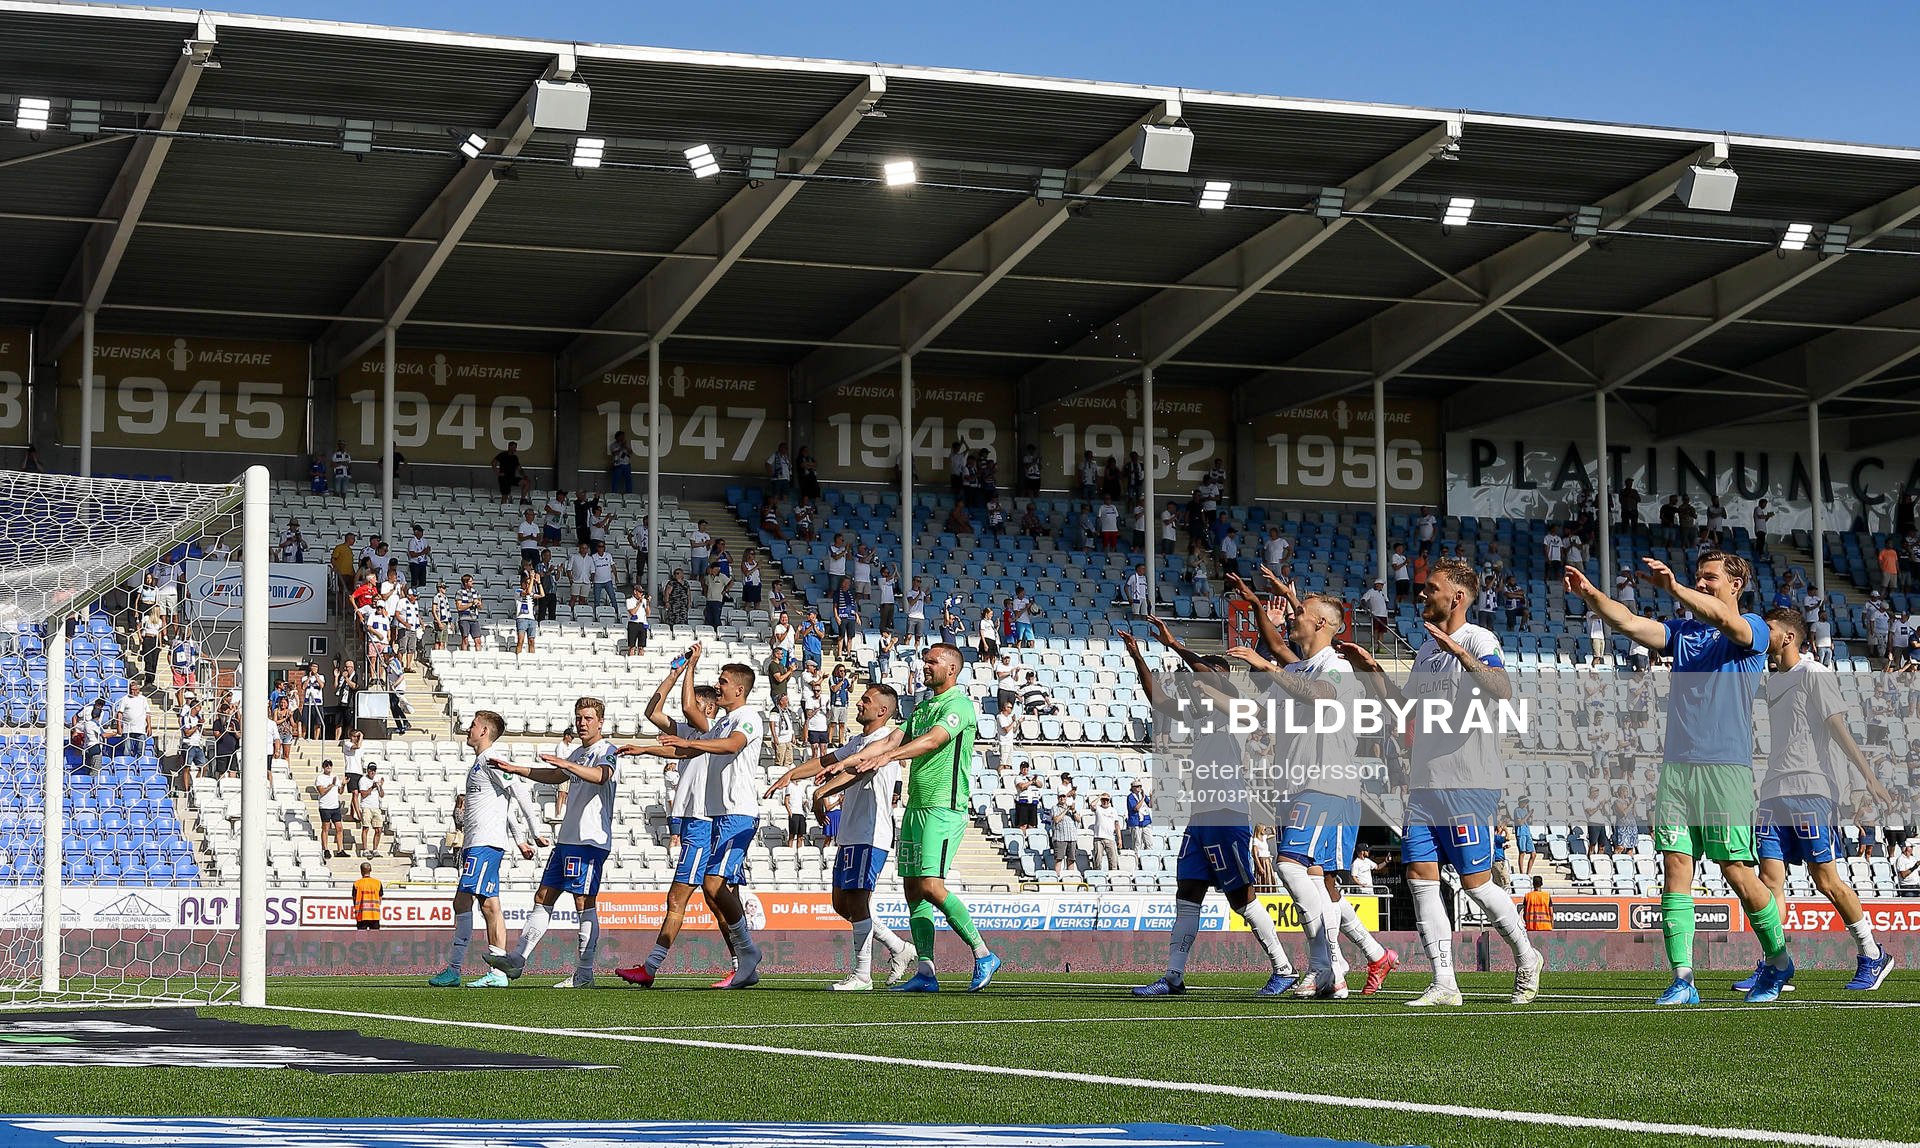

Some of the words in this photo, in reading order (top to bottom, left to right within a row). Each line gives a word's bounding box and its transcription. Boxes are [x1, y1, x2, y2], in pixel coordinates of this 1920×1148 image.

[92, 346, 161, 360] SVENSKA
[199, 350, 272, 365] MÄSTARE
[457, 366, 521, 379] MÄSTARE
[602, 373, 663, 386] SVENSA
[695, 377, 756, 391] MÄSTARE
[837, 386, 895, 398] SVENSKA
[925, 389, 985, 402] MÄSTARE
[78, 375, 285, 440] 1945
[350, 389, 534, 451] 1946
[1356, 410, 1412, 424] MÄTARE
[596, 401, 766, 461] 1947
[828, 412, 997, 470] 1948
[1053, 423, 1215, 482] 1952
[1266, 433, 1424, 490] 1956
[312, 638, 324, 653] L
[1419, 678, 1459, 695] OLMEN
[306, 905, 402, 921] STENGS
[407, 907, 425, 921] EL
[429, 907, 452, 921] AB
[596, 901, 659, 912] Tillsammans
[772, 904, 789, 914] DU
[791, 902, 809, 914] ÄR
[968, 902, 1041, 914] STÅTHÖGA
[1058, 902, 1131, 914] STÅTHÖGA
[973, 918, 1022, 928] ERKSTAD
[1023, 918, 1039, 928] AB
[1055, 918, 1110, 929] VERKSTAD
[1113, 918, 1129, 928] AB
[1202, 918, 1217, 928] AB
